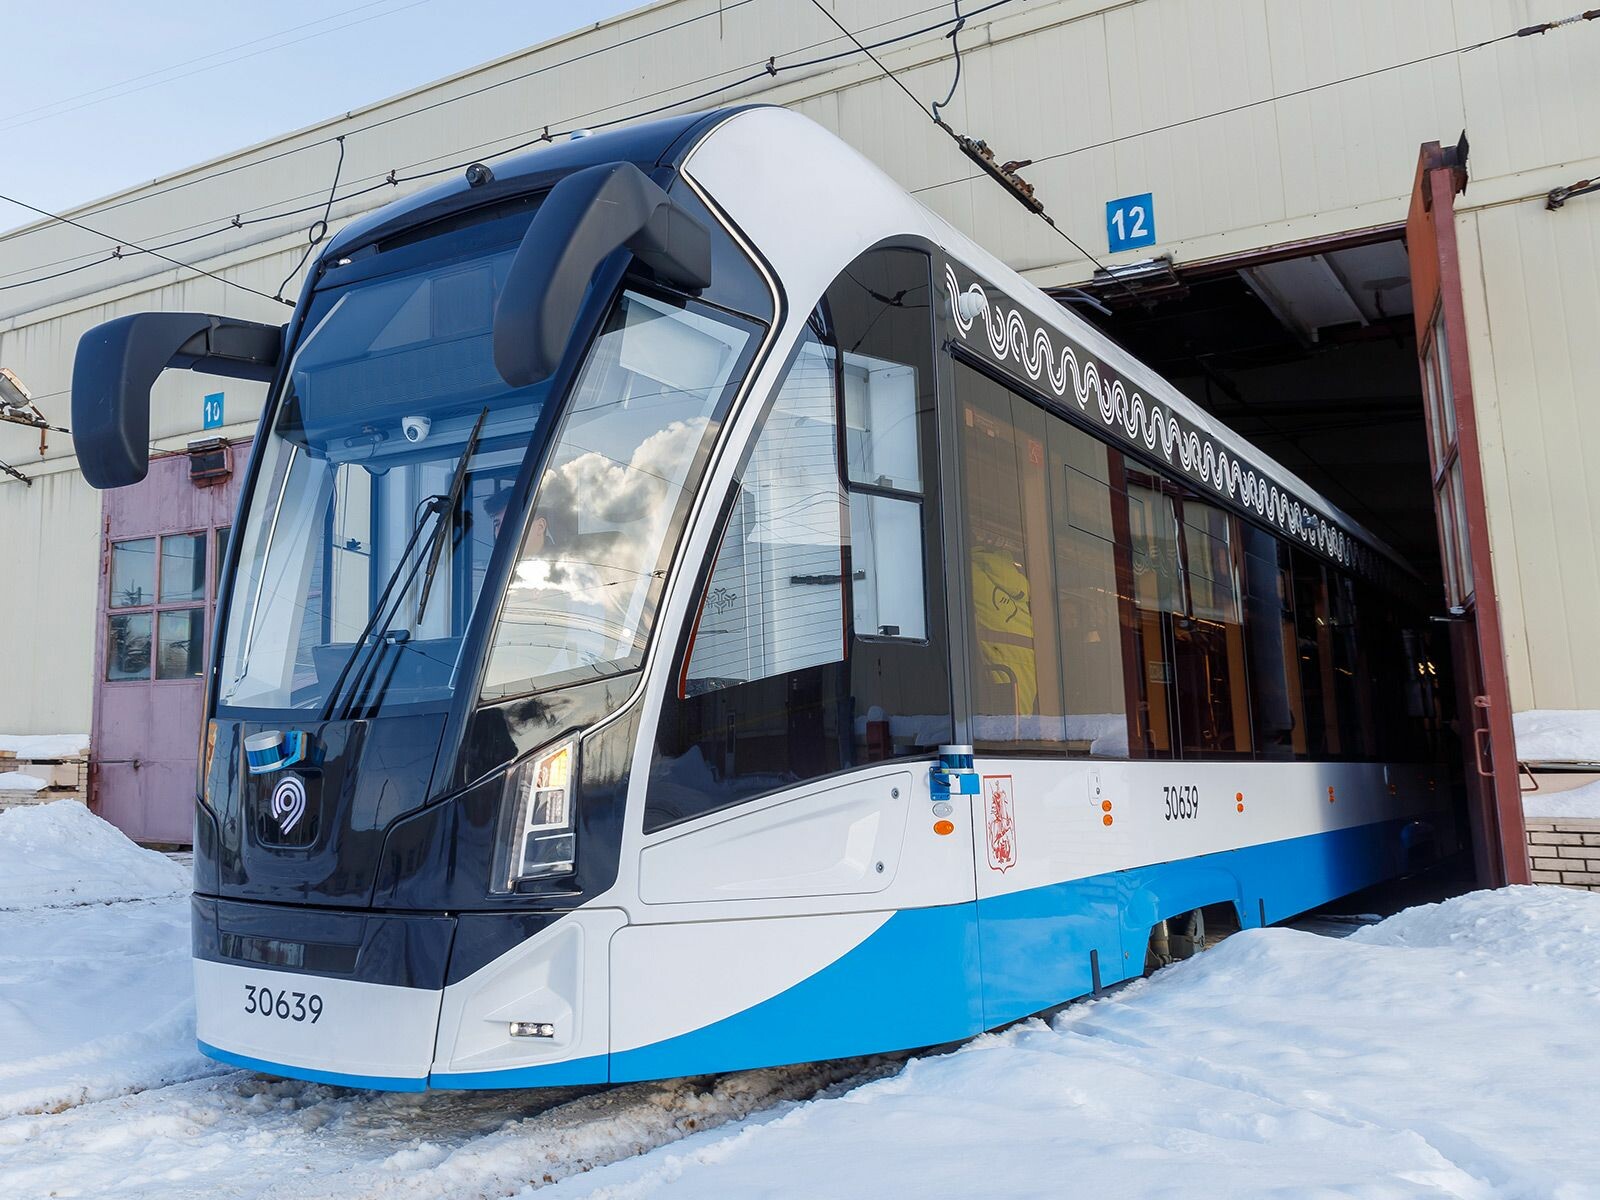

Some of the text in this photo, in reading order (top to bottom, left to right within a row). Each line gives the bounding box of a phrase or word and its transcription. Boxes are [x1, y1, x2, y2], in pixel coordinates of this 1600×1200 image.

[1112, 206, 1148, 240] 12
[205, 401, 220, 422] 10
[1163, 785, 1199, 820] 30639
[244, 984, 323, 1024] 30639
